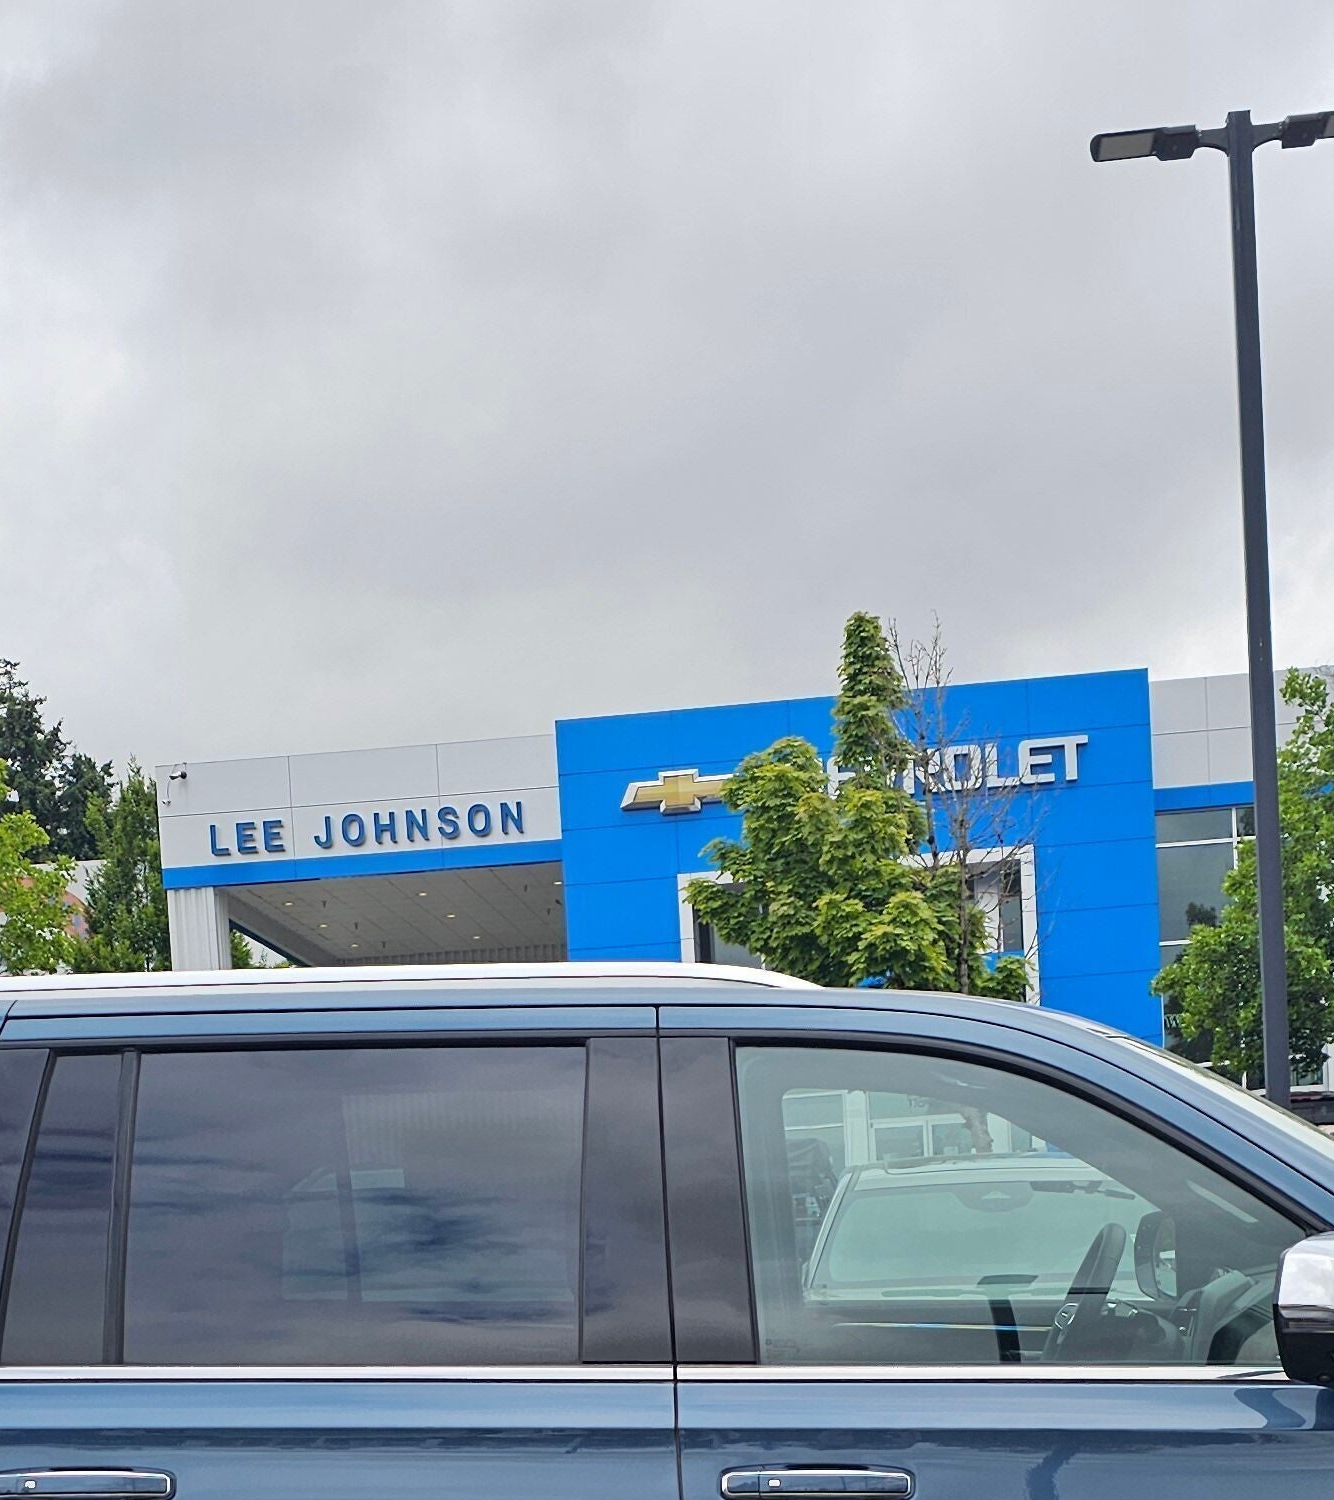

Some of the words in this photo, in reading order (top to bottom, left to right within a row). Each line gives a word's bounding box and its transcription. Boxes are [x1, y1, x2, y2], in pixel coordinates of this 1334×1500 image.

[815, 734, 1089, 798] EROLET
[209, 819, 286, 857] LEE
[314, 801, 525, 850] JOHNSON
